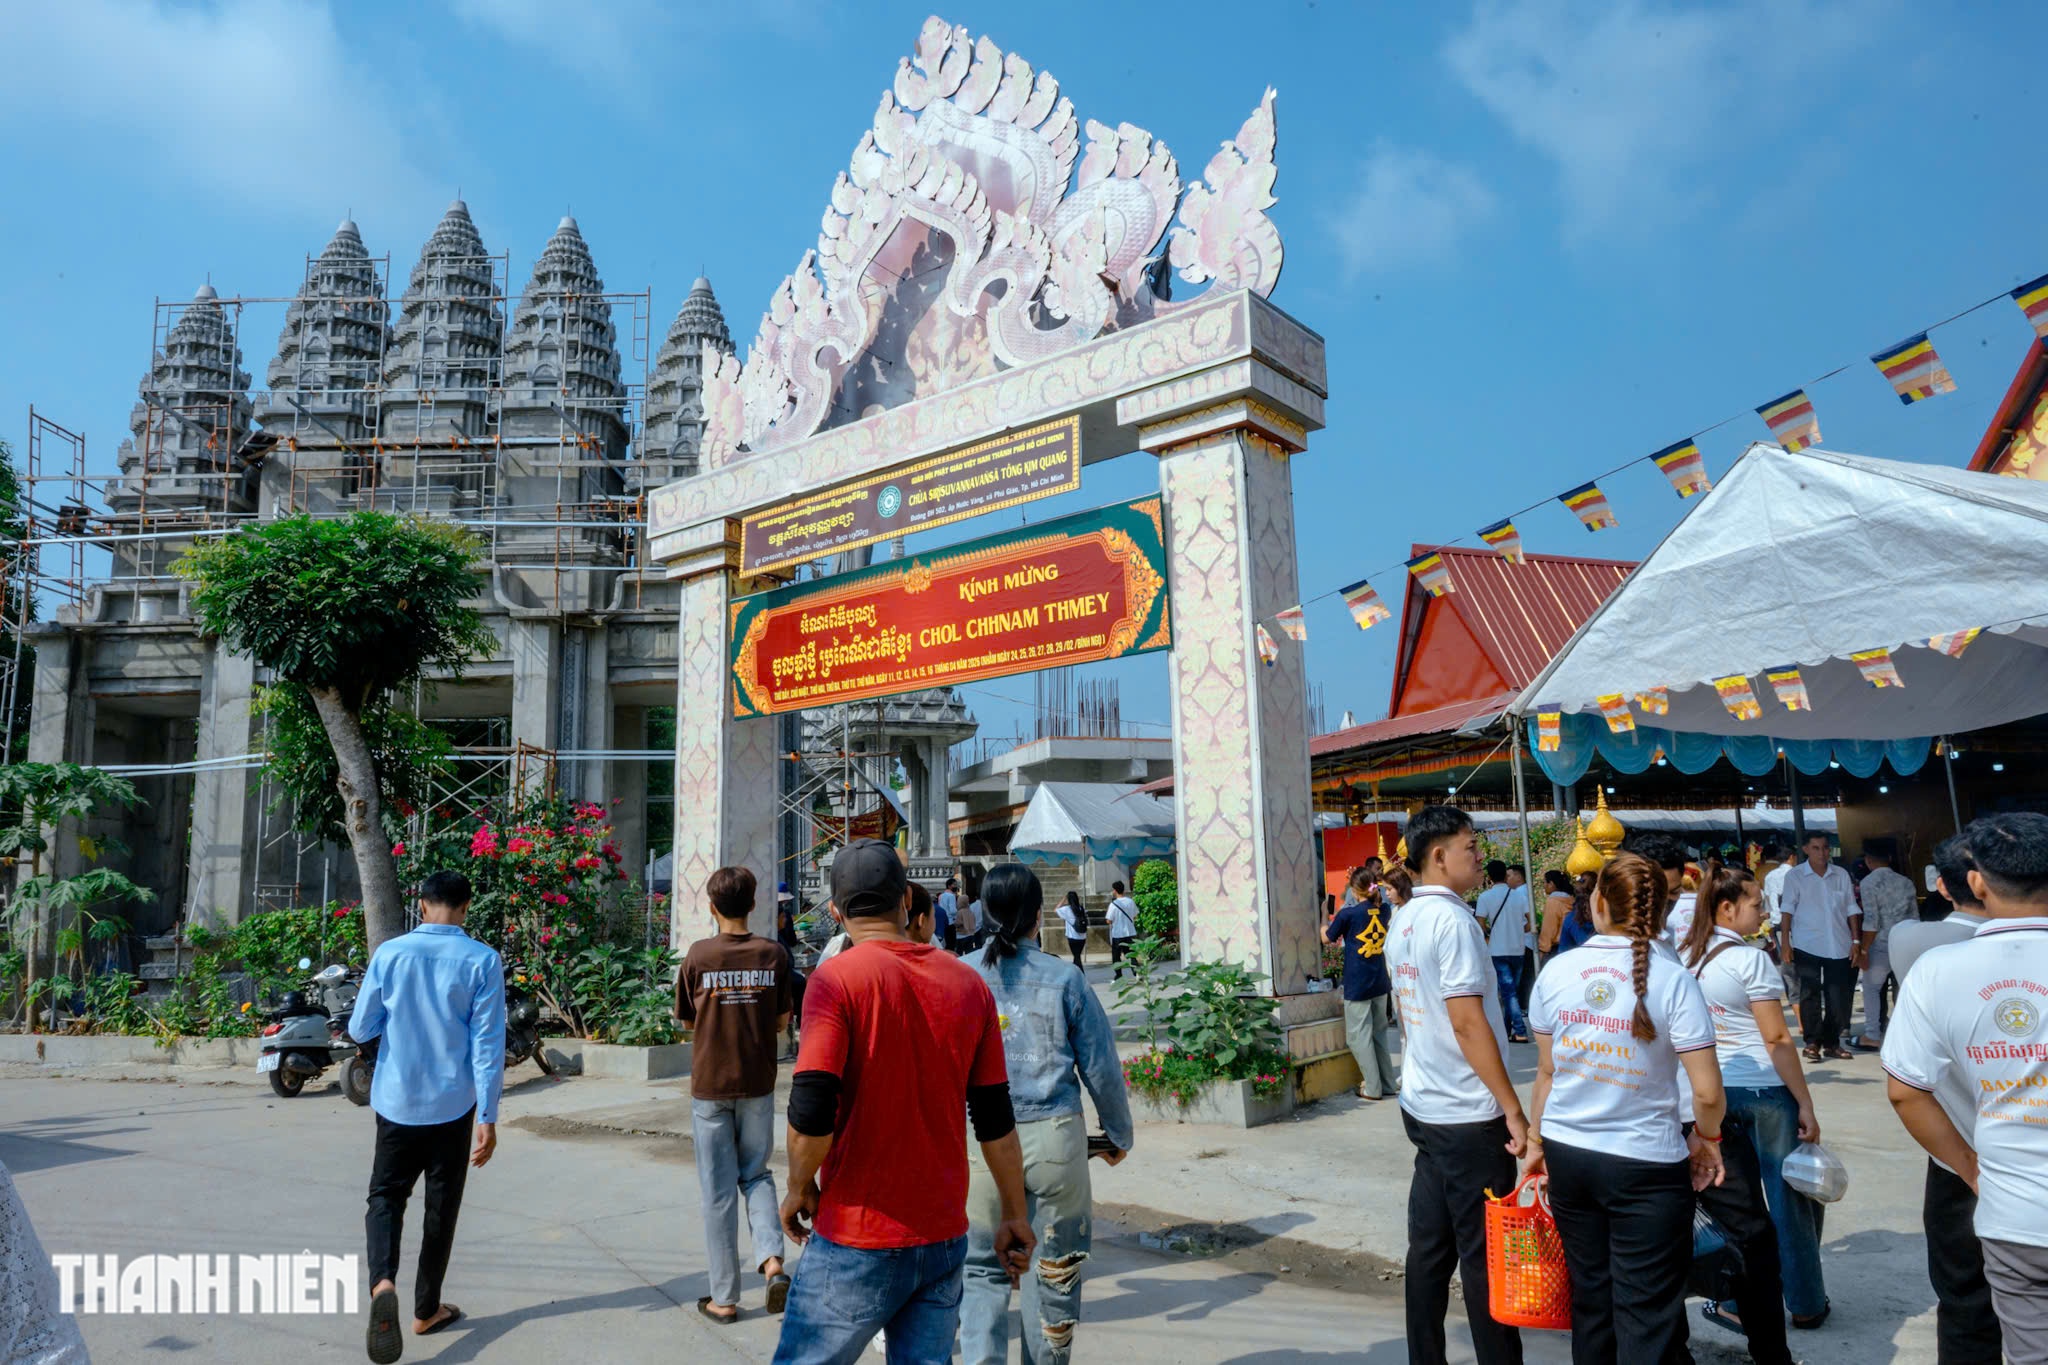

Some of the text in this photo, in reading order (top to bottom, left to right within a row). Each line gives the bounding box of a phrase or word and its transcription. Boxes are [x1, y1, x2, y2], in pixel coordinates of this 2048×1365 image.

[909, 489, 928, 506] CHÙA
[1024, 459, 1038, 476] KIM
[1039, 450, 1068, 471] QUANG
[959, 563, 1059, 603] KÍNH MỪNG
[919, 591, 1110, 648] CHOL CHHNAM THMEY
[702, 970, 775, 989] HYSTERCIAL
[1561, 1035, 1588, 1051] BAN
[1589, 1042, 1613, 1057] HỘ
